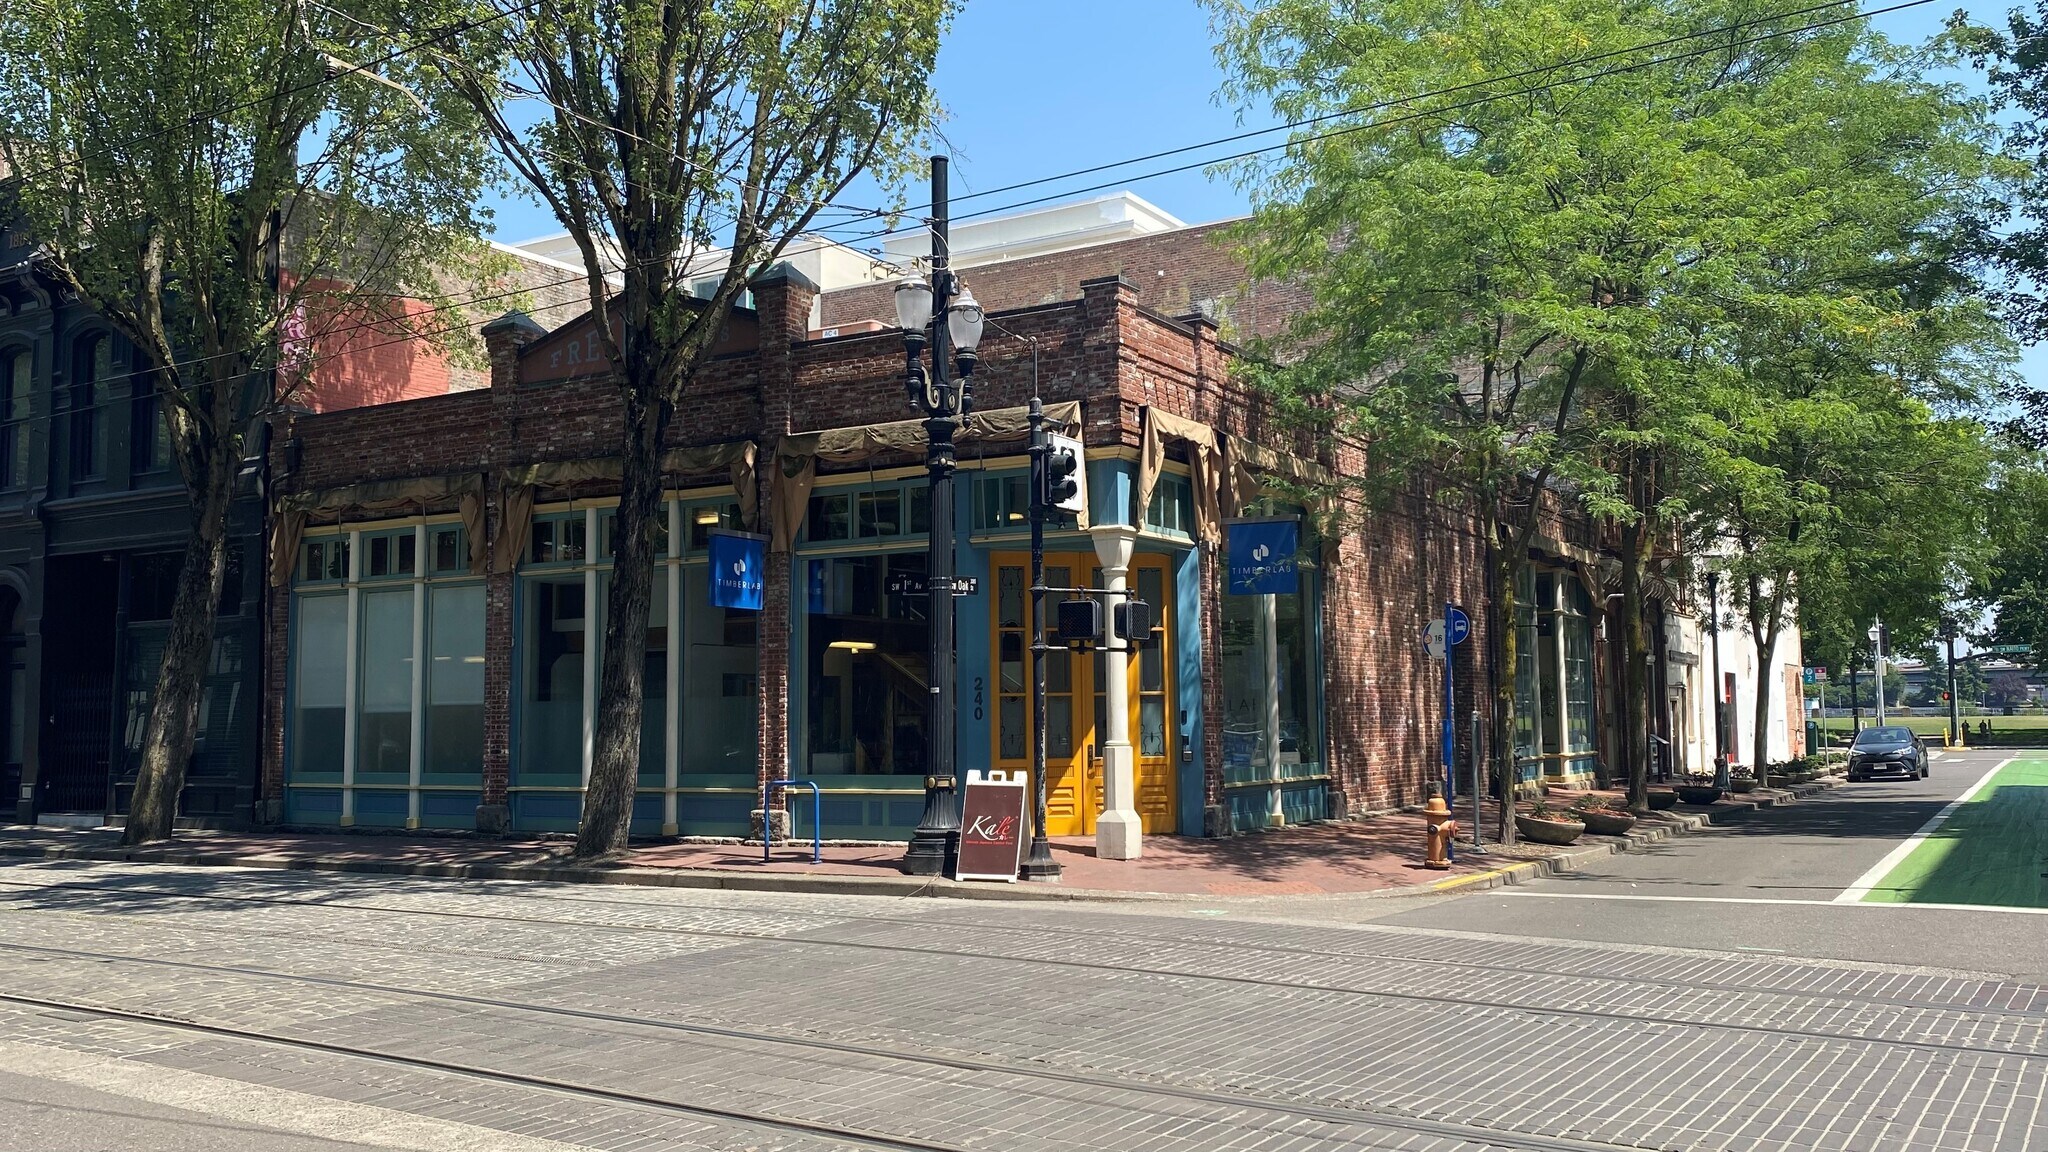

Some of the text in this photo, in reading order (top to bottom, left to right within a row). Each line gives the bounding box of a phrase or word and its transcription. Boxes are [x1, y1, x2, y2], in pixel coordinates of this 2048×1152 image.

[718, 579, 761, 590] TIMBERLAB
[891, 583, 900, 591] SW
[904, 580, 912, 591] 1st
[958, 580, 969, 591] Oak
[974, 677, 983, 720] 240
